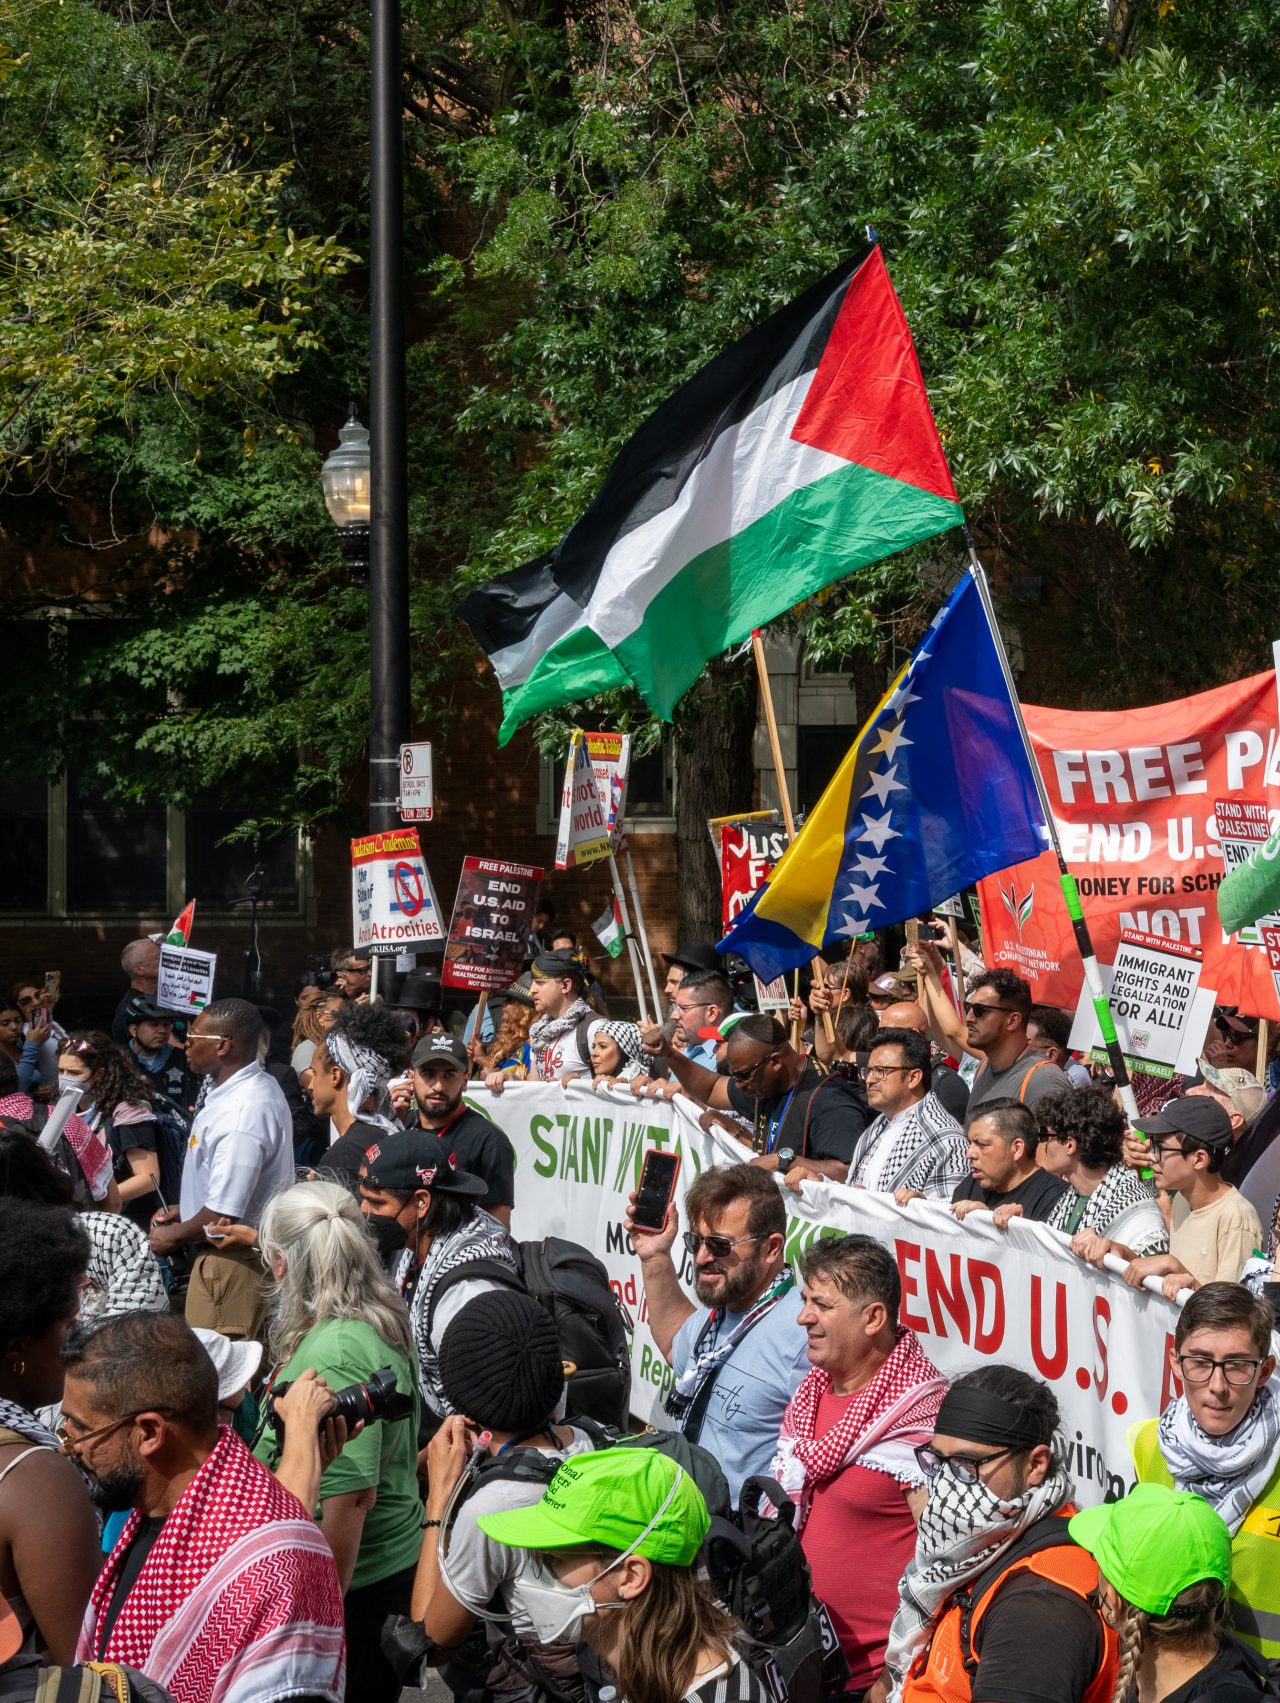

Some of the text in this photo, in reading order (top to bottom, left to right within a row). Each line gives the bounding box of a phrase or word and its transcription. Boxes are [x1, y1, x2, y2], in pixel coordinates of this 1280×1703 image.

[1052, 742, 1208, 804] FREE
[403, 808, 429, 818] TOW ZONE
[574, 804, 603, 832] world
[1215, 802, 1267, 820] STAND WITH
[1218, 819, 1270, 839] PALESTINE!
[1061, 822, 1152, 864] END
[358, 868, 367, 883] the
[479, 861, 534, 878] FREE PALESTINE
[488, 880, 521, 895] END
[1138, 875, 1175, 895] FOR
[473, 894, 526, 910] U.S. AID
[490, 913, 509, 925] TO
[1119, 906, 1206, 946] NOT
[371, 919, 440, 941] Atrocities
[465, 926, 519, 942] ISRAEL
[1123, 930, 1193, 954] STAND WITH PALESTINE
[454, 963, 474, 972] MONEY
[1118, 953, 1195, 984] IMMIGRANT
[1114, 970, 1190, 999] RIGHTS AND
[1110, 984, 1187, 1012] LEGALIZATION
[1109, 998, 1184, 1031] FOR ALL!
[431, 1044, 453, 1052] adidas
[1092, 1050, 1106, 1060] END
[1145, 1064, 1172, 1076] ISRAEL!
[530, 1113, 613, 1187] STAND
[895, 1239, 1005, 1355] END
[1030, 1274, 1129, 1416] U.S.
